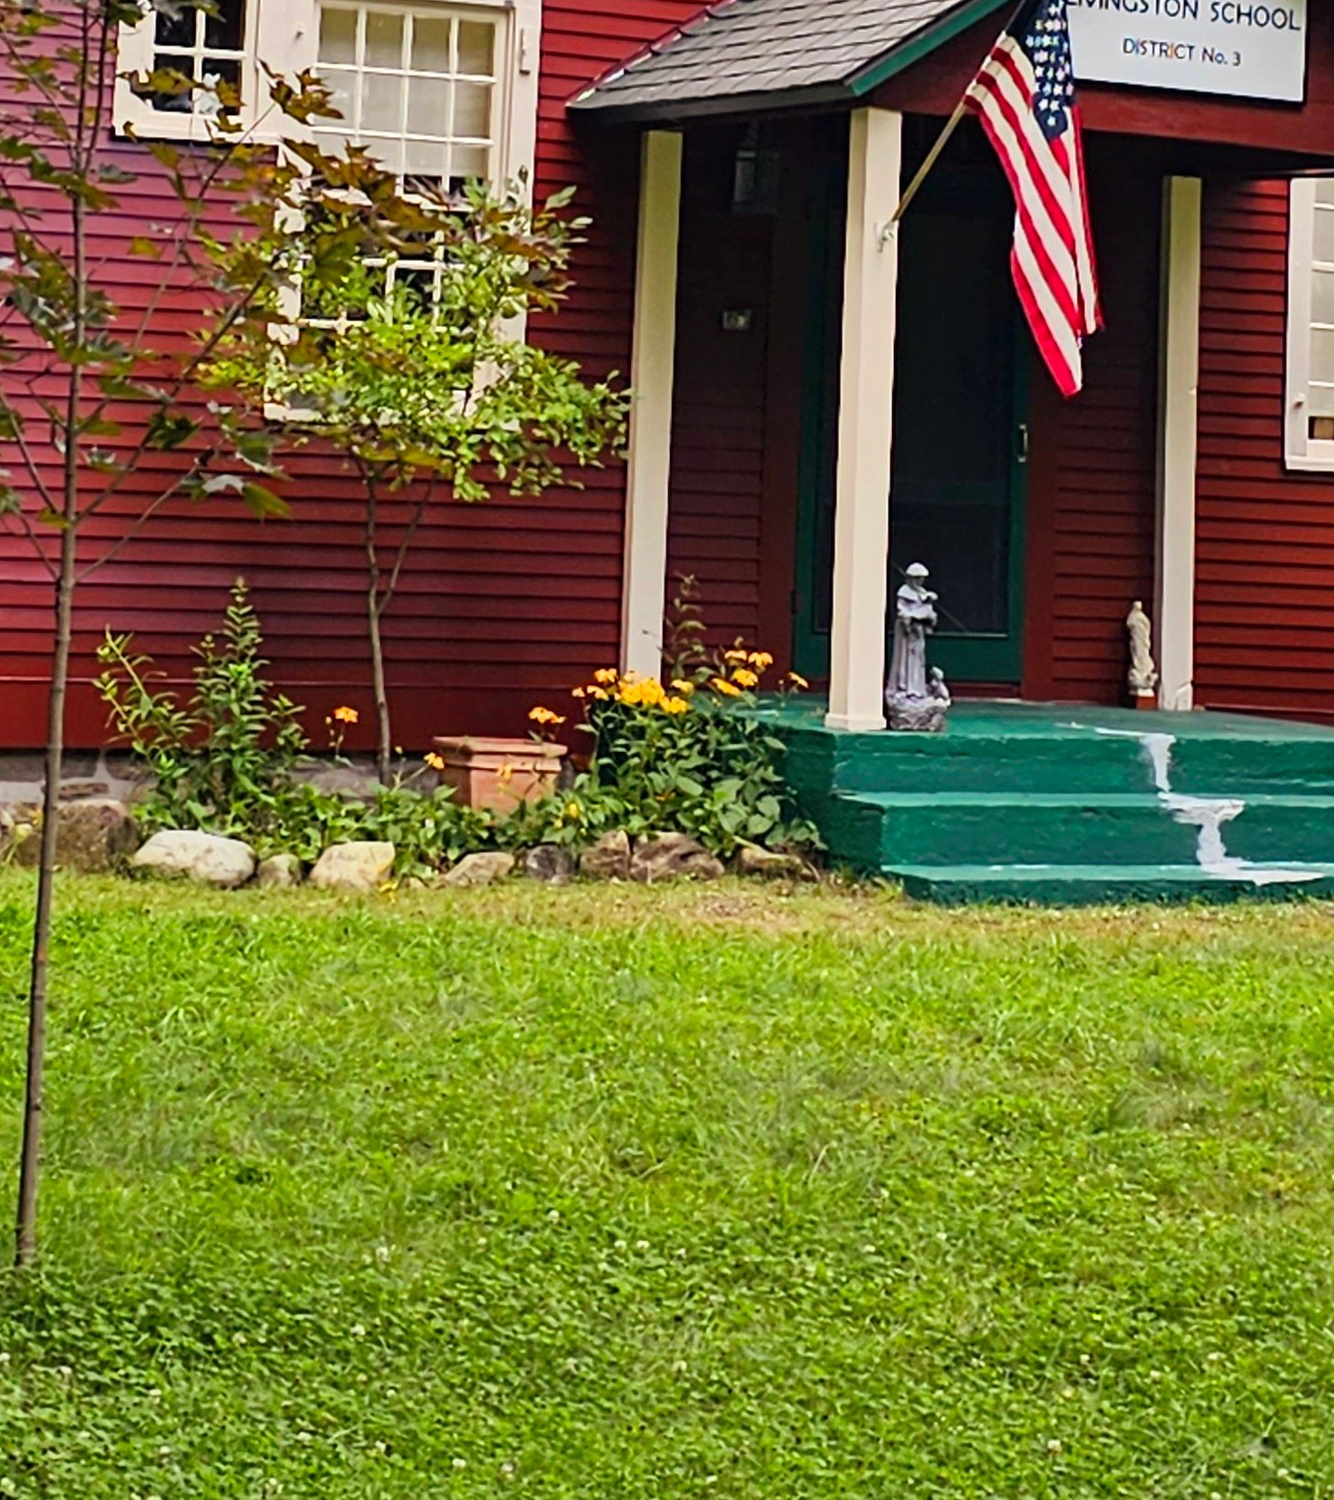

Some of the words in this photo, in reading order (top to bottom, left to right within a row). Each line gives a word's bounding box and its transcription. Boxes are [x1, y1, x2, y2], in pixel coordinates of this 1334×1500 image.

[1210, 1, 1301, 31] SCHOOL
[1123, 37, 1195, 60] DISTRICT
[1201, 47, 1228, 64] No.
[1232, 51, 1242, 67] 3
